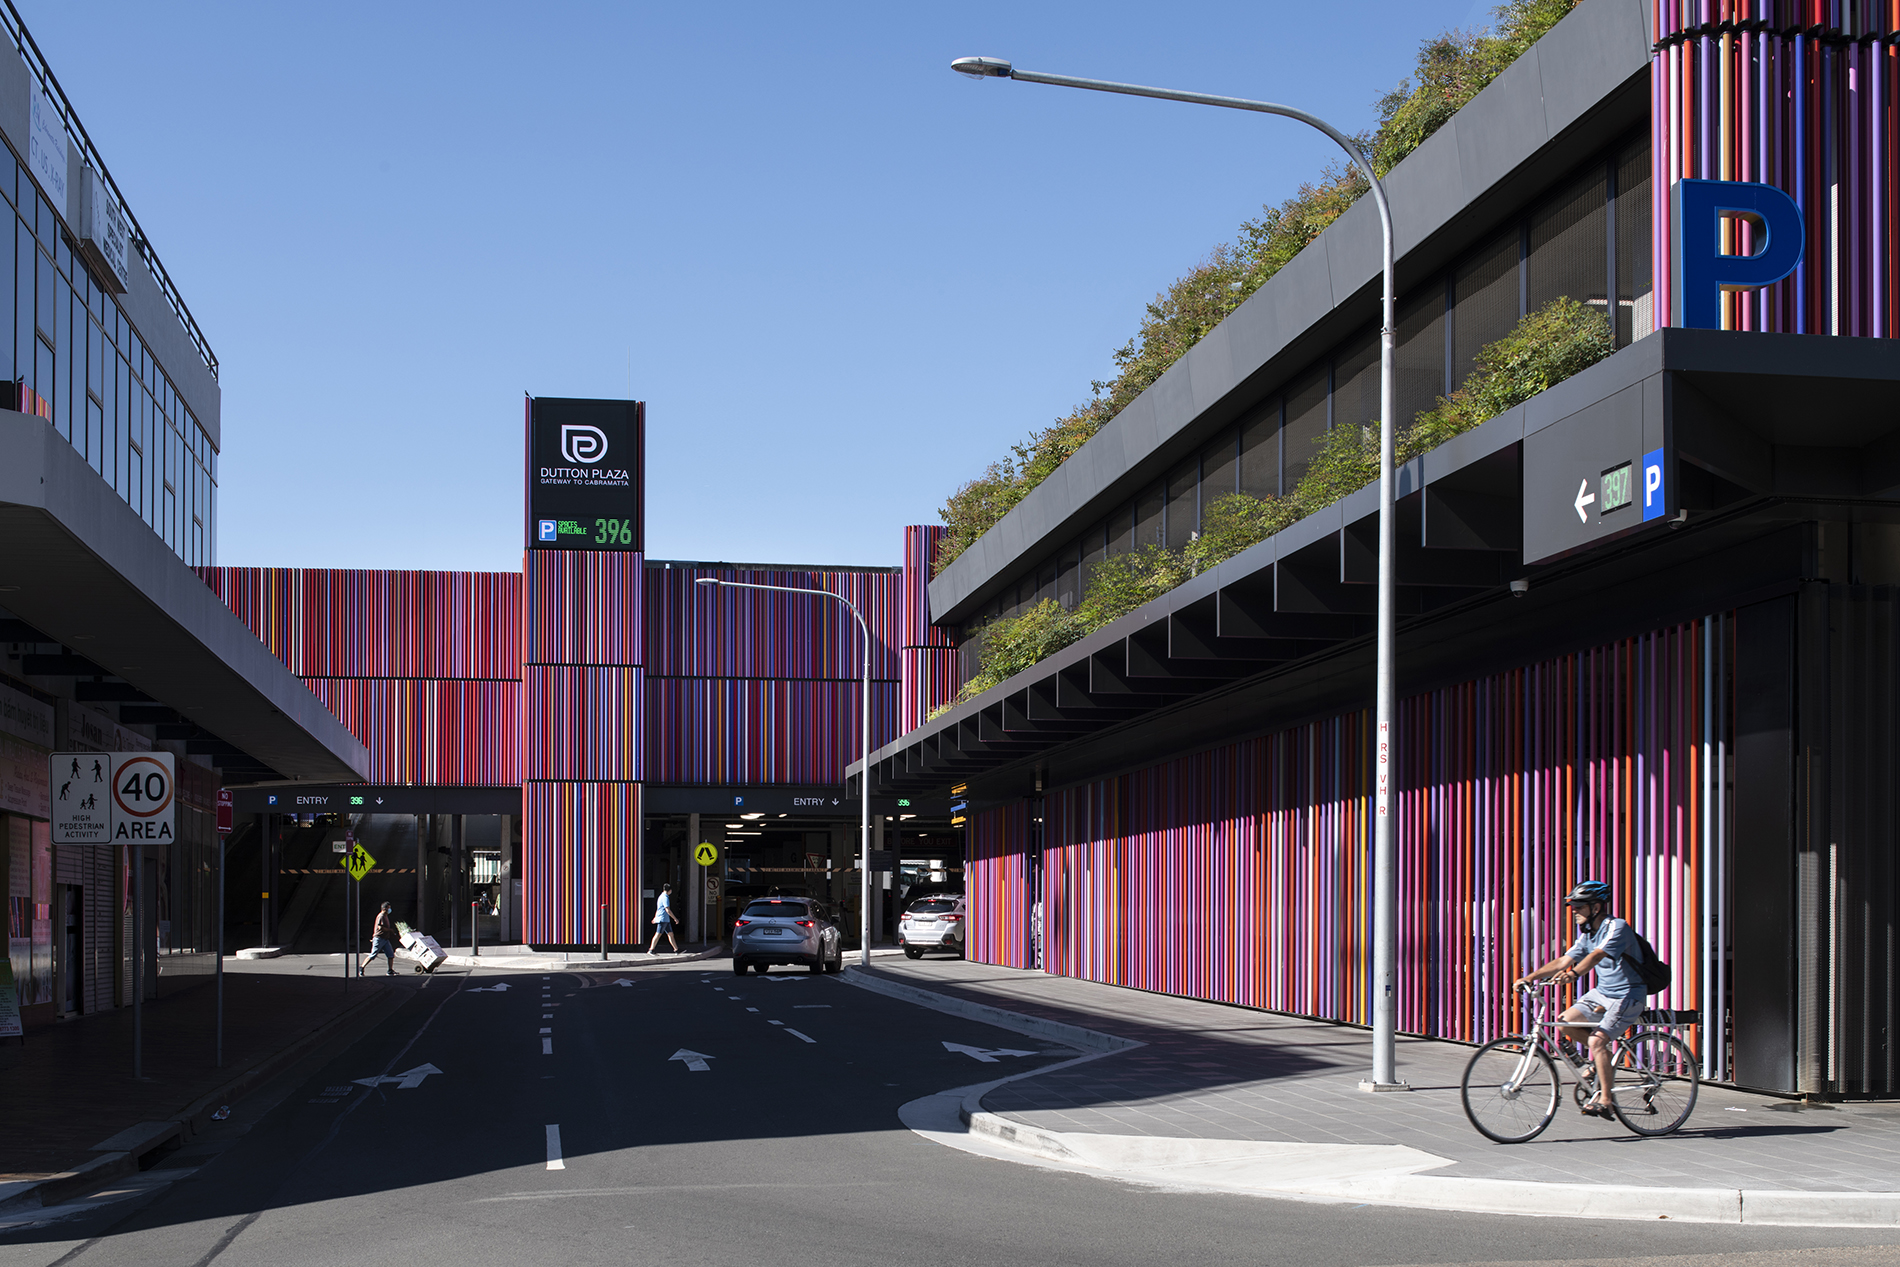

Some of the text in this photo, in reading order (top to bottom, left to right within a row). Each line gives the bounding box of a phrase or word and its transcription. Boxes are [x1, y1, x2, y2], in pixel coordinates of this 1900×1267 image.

[1671, 178, 1806, 331] P
[540, 467, 629, 479] DUTTON PLAZA
[1603, 467, 1629, 510] 397
[1646, 464, 1661, 507] P
[541, 522, 554, 538] P
[595, 519, 632, 544] 396
[82, 713, 102, 746] Josan
[121, 772, 165, 802] 40
[269, 796, 276, 804] P
[296, 796, 329, 804] ENTRY
[350, 796, 363, 805] 396
[736, 797, 742, 805] P
[794, 798, 825, 806] ENTRY
[115, 821, 172, 839] AREA
[918, 837, 934, 845] YOU
[790, 853, 797, 863] G
